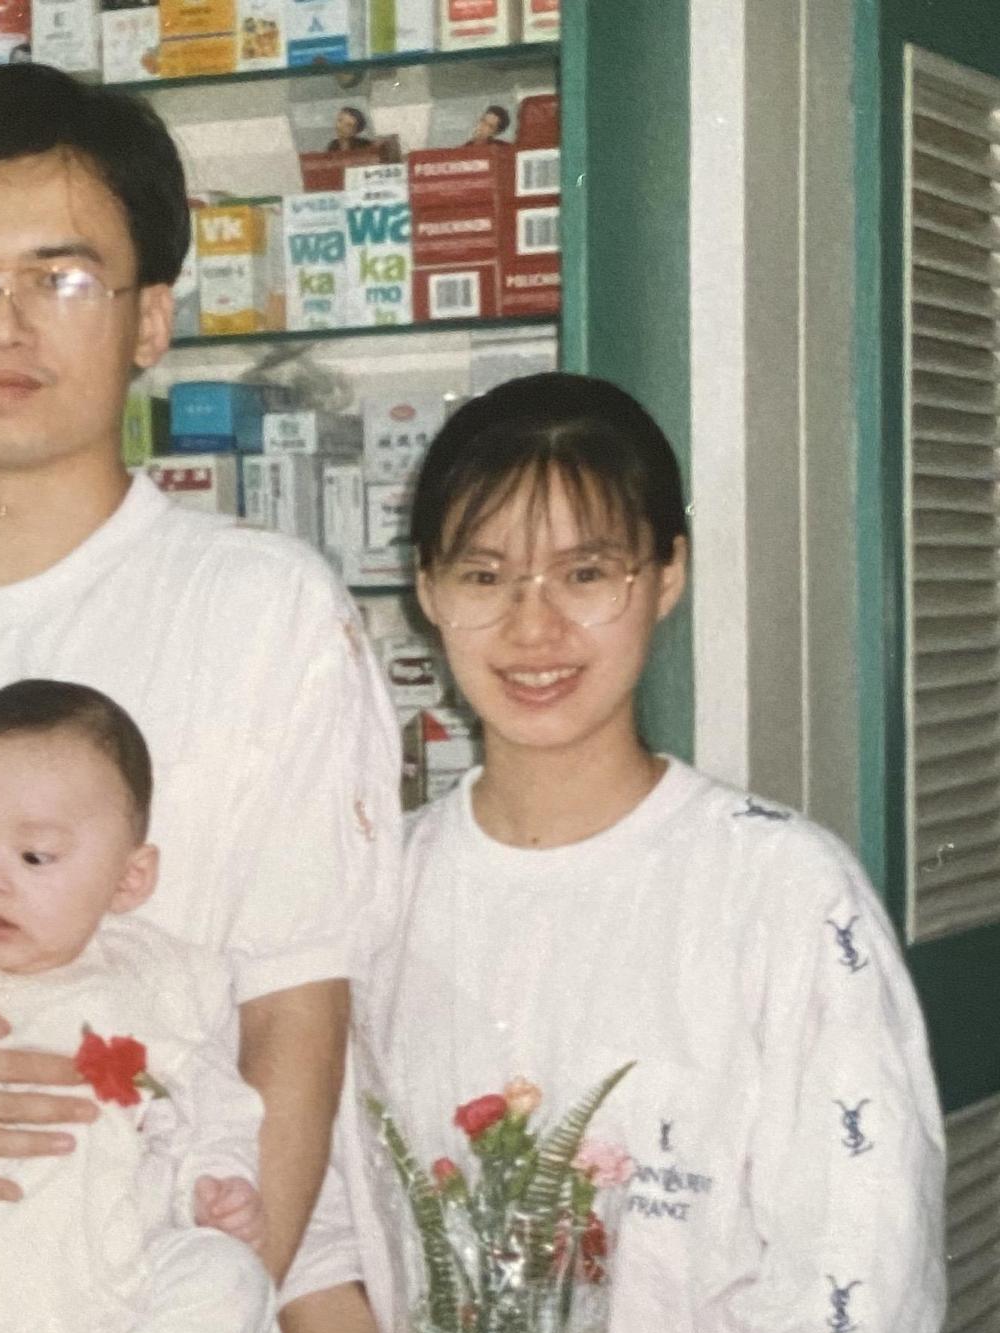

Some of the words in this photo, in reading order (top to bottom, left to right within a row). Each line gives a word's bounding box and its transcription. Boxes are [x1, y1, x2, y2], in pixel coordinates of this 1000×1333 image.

[289, 231, 346, 265] wa
[359, 248, 406, 284] ka
[366, 286, 402, 304] mo
